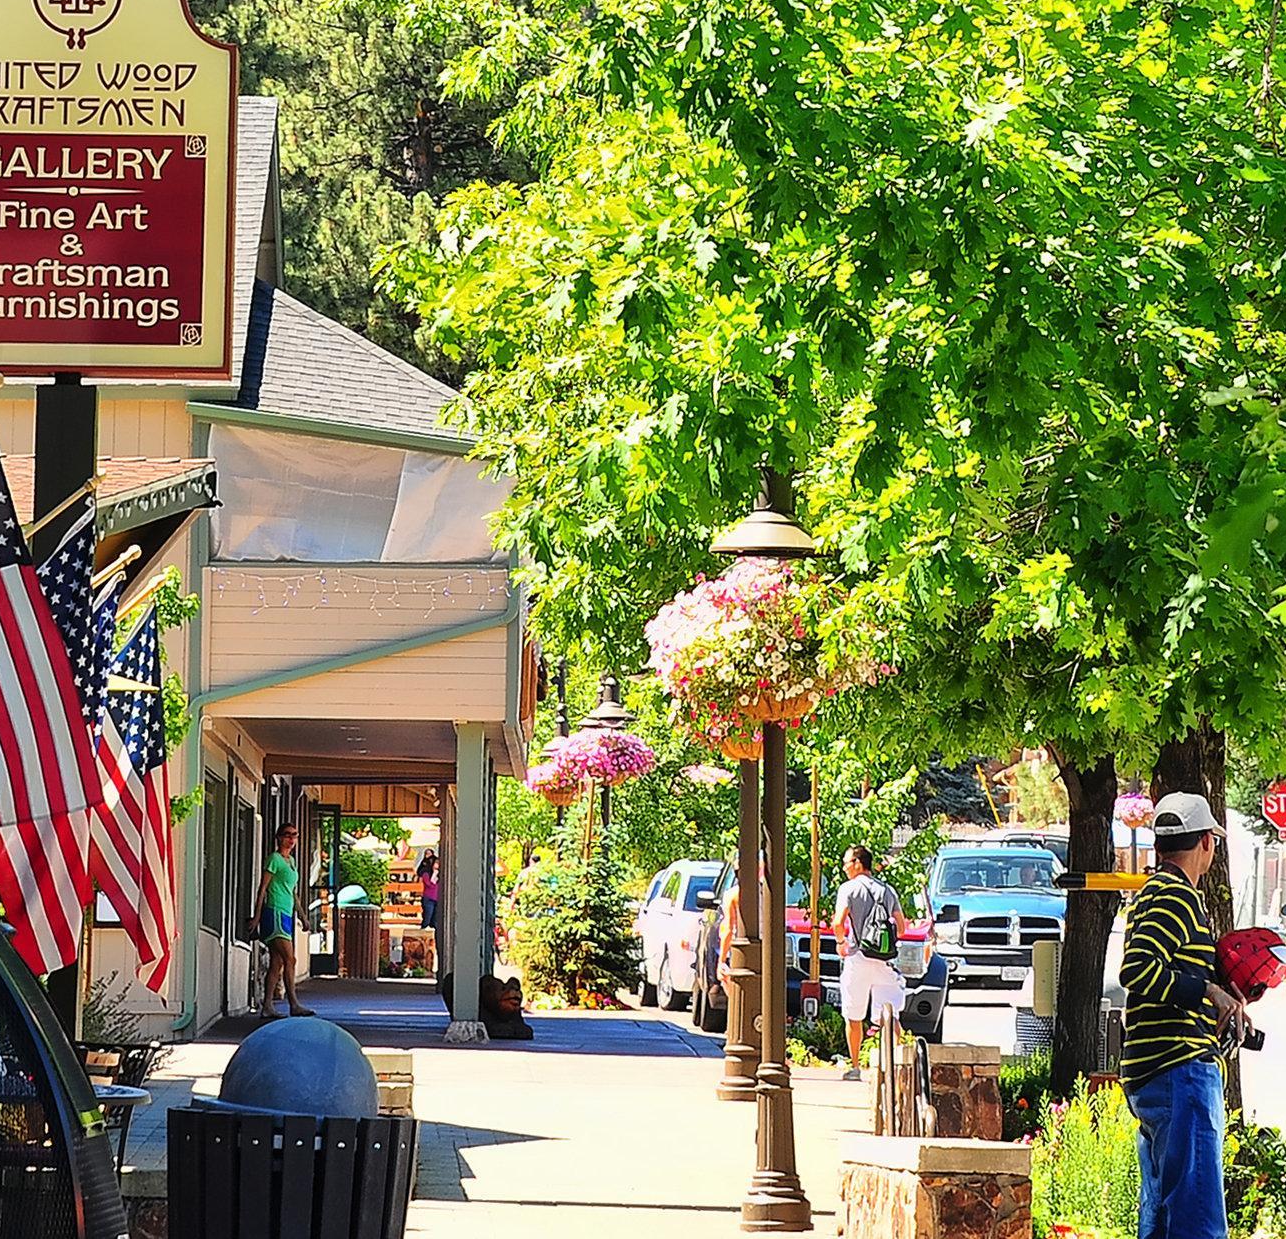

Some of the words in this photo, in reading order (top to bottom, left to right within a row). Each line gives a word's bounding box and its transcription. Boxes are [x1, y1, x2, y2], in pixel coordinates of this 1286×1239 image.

[97, 62, 198, 92] WOOD
[86, 202, 149, 231] Art
[59, 233, 84, 256] &
